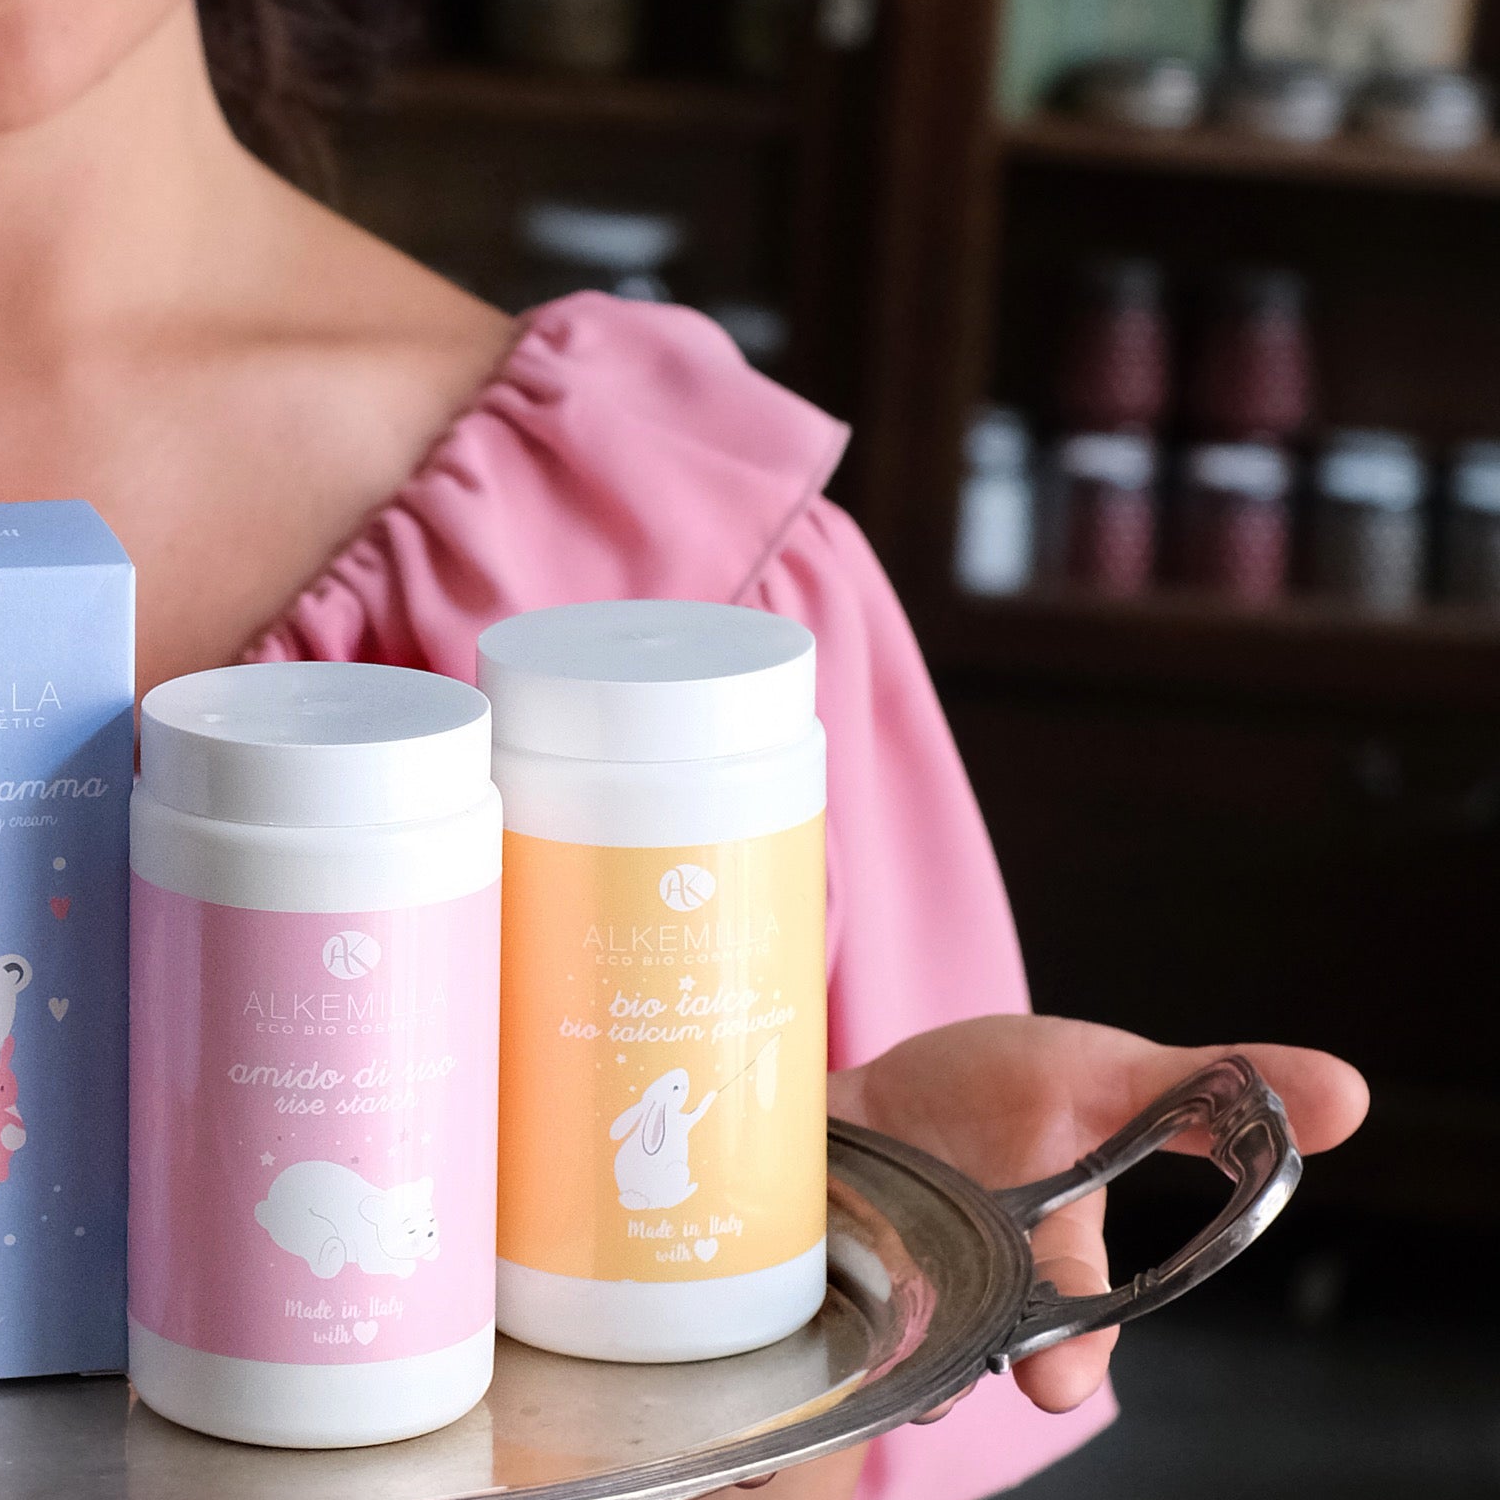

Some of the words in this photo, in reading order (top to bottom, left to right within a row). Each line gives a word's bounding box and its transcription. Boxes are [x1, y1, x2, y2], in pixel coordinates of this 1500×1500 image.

[9, 815, 58, 829] cream
[583, 911, 780, 952] ALKEMILLA
[596, 954, 632, 966] ECO
[643, 954, 675, 966] BIO
[243, 983, 449, 1020] ALKEMILLA
[608, 990, 668, 1018] bio
[675, 987, 760, 1017] talco
[256, 1022, 294, 1035] ECO
[304, 1024, 337, 1036] BIO
[559, 1016, 602, 1040] bio
[608, 1020, 705, 1042] talcum
[711, 1005, 797, 1044] powder
[228, 1060, 346, 1090] amido
[352, 1058, 392, 1088] di
[402, 1055, 458, 1083] riso
[274, 1093, 326, 1115] rise
[335, 1086, 419, 1115] starch
[627, 1219, 675, 1239] Made
[683, 1220, 701, 1238] in
[709, 1213, 744, 1237] Italy
[656, 1242, 692, 1262] with
[284, 1298, 335, 1320] Made
[341, 1300, 362, 1319] in
[369, 1295, 404, 1320] Italy
[313, 1323, 351, 1344] with
